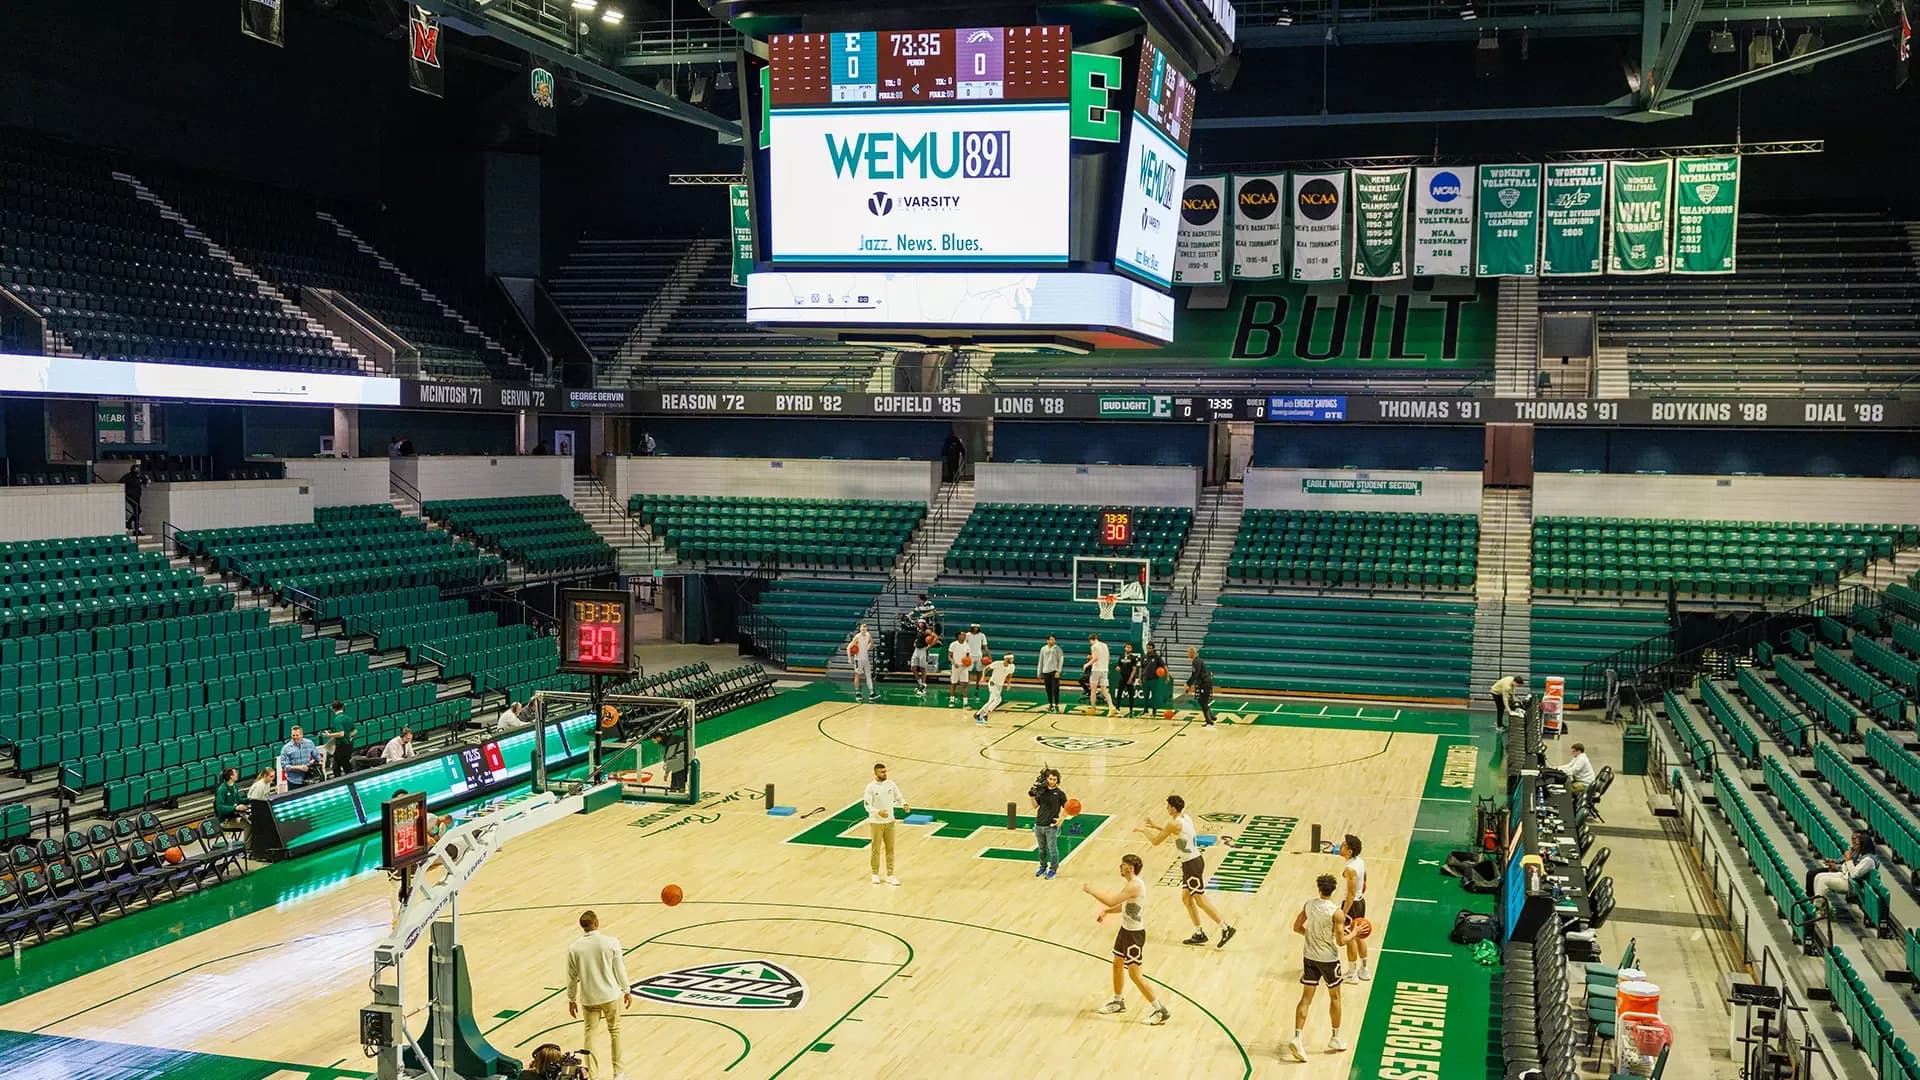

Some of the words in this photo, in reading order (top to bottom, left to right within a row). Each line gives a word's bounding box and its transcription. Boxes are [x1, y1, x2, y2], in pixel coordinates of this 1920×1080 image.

[411, 17, 440, 68] M
[845, 33, 860, 52] E
[890, 33, 940, 56] 73:35
[848, 56, 859, 78] 0
[974, 53, 986, 75] 0
[1070, 50, 1121, 143] E
[825, 131, 960, 179] WEMU
[965, 133, 1008, 176] 89.1
[1490, 168, 1530, 178] WOMEN'S
[1688, 162, 1728, 172] WOMEN'S
[1483, 179, 1537, 187] VOLLEYBALL
[1548, 177, 1602, 186] VOLLEYBALL
[1680, 172, 1736, 182] GYMNASTICS
[1432, 186, 1462, 195] NCAA
[904, 196, 960, 207] VARSITY
[1183, 200, 1218, 210] NCAA
[1240, 192, 1276, 204] NCAA
[1301, 193, 1336, 204] NCAA
[1570, 209, 1600, 217] DIVISION
[1618, 201, 1661, 222] WIVC
[1680, 206, 1734, 214] CHAMPIONS
[1616, 222, 1662, 232] TOURNAMENT
[1680, 216, 1702, 224] 2007
[1310, 224, 1340, 232] BASKETBALL
[1562, 228, 1584, 236] 2005
[857, 234, 892, 251] Jazz.
[897, 234, 937, 251] News.
[942, 232, 982, 251] Blues.
[1310, 240, 1340, 248] TOURNAMENT
[1680, 236, 1702, 244] 2017
[1680, 245, 1701, 253] 2021
[1234, 264, 1241, 274] E
[1272, 264, 1280, 274] E
[1356, 262, 1364, 274] E
[1392, 262, 1400, 274] E
[1480, 264, 1488, 274] E
[1525, 264, 1533, 274] E
[1592, 260, 1600, 269] E
[1614, 257, 1622, 268] E
[1655, 256, 1664, 268] E
[1176, 271, 1182, 280] E
[1214, 270, 1221, 280] E
[1294, 268, 1302, 278] E
[1332, 268, 1340, 278] E
[1416, 266, 1424, 274] E
[1460, 266, 1468, 274] E
[1230, 295, 1479, 361] BUILT
[420, 385, 466, 404] MCINTOSH
[470, 387, 482, 405] '71
[501, 390, 530, 406] GERVIN
[532, 391, 544, 407] '72
[570, 392, 598, 400] GEORGE
[598, 392, 624, 401] GERVIN
[662, 394, 716, 410] REASON
[721, 394, 744, 410] '72
[776, 395, 813, 410] BYRD
[818, 396, 842, 411] '82
[874, 396, 932, 412] COFIELD
[938, 396, 961, 413] '85
[994, 398, 1033, 414] LONG
[1040, 398, 1064, 414] '88
[1103, 402, 1122, 410] BUD
[1122, 402, 1148, 410] LIGHT
[1152, 396, 1172, 417] E
[1208, 398, 1232, 410] 73:35
[1272, 398, 1284, 408] WIN
[1294, 399, 1314, 408] ENERGY
[1315, 399, 1338, 408] SAVINGS
[1379, 400, 1449, 418] THOMAS
[1456, 402, 1480, 418] '91
[1184, 406, 1192, 416] 0
[1256, 407, 1264, 418] 0
[1515, 402, 1587, 420] THOMAS
[1594, 402, 1618, 420] '91
[1652, 402, 1731, 421] BOYKINS
[1738, 404, 1768, 422] '98
[1805, 404, 1846, 422] DIAL
[1854, 404, 1884, 422] '98
[1306, 480, 1326, 488] EAGLE
[1328, 480, 1354, 488] NATION
[1356, 480, 1386, 489] STUDENT
[1104, 514, 1128, 524] 73:35
[1107, 524, 1125, 540] 30
[576, 602, 622, 624] 73:35
[580, 626, 616, 660] 30
[118, 819, 130, 834] E
[142, 814, 153, 828] E
[94, 826, 106, 840] E
[180, 827, 192, 842] E
[203, 821, 214, 836] E
[1233, 815, 1299, 852] GEORGE
[69, 832, 82, 848] E
[158, 834, 170, 849] E
[16, 847, 30, 862] E
[43, 840, 56, 855] E
[134, 840, 147, 856] E
[106, 848, 120, 864] E
[80, 856, 92, 871] E
[464, 850, 488, 880] LEGACY
[52, 864, 64, 880] E
[1204, 850, 1278, 894] GERVIN
[24, 872, 38, 888] E
[420, 896, 448, 930] SPORTS
[1378, 981, 1449, 1080] EMUEAGLES
